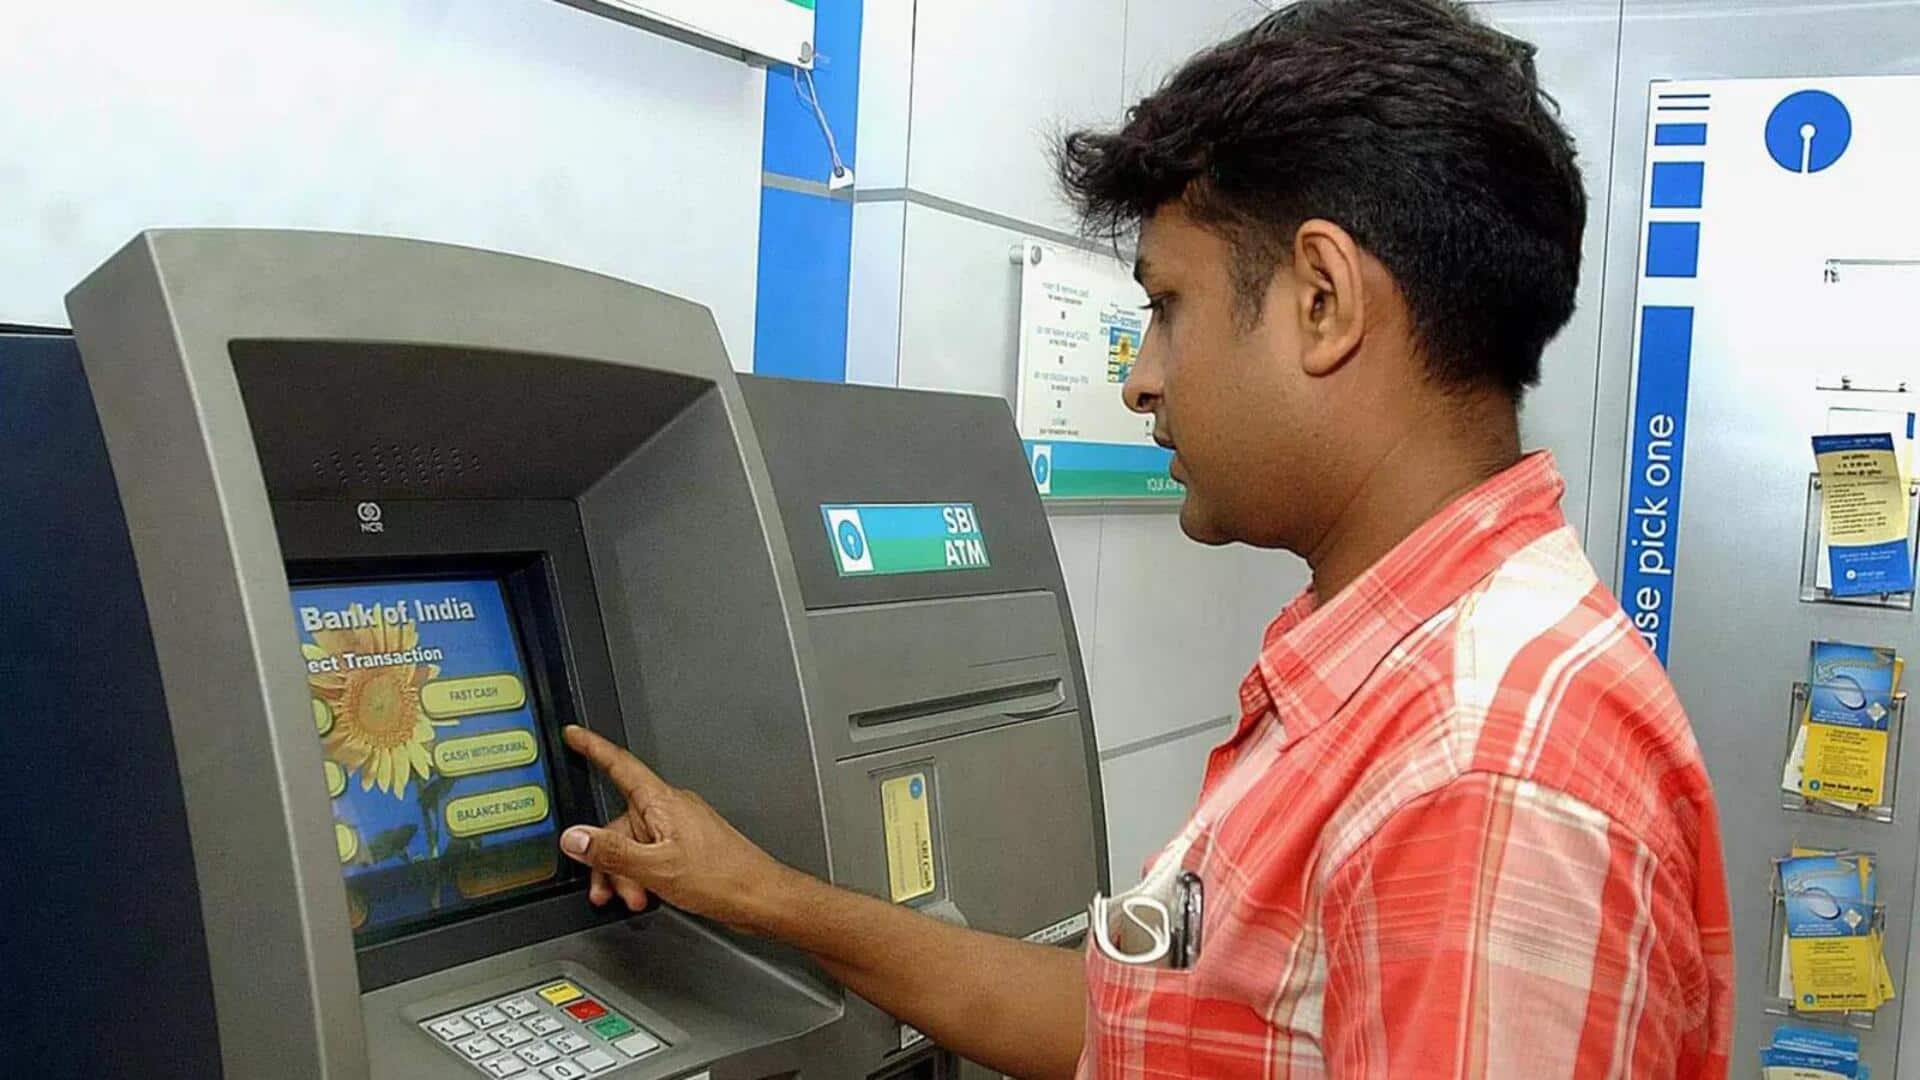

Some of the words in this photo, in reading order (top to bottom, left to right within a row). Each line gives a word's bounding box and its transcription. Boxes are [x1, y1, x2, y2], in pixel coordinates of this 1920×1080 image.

[1646, 414, 1674, 487] one
[361, 521, 384, 533] NCR
[943, 506, 979, 533] SBI
[1632, 496, 1671, 575] pick
[945, 539, 987, 566] ATM
[300, 604, 377, 633] Bank
[383, 600, 411, 626] of
[414, 597, 475, 622] India
[343, 647, 443, 670] Transaction
[449, 689, 473, 702] FAST
[473, 687, 499, 699] CASH
[442, 750, 470, 763] CASH
[455, 804, 500, 822] BALANCE
[473, 1015, 489, 1026] 2
[441, 1027, 454, 1036] 1
[499, 1032, 513, 1043] 5
[489, 1063, 504, 1074] 7
[555, 1065, 571, 1077] 0
